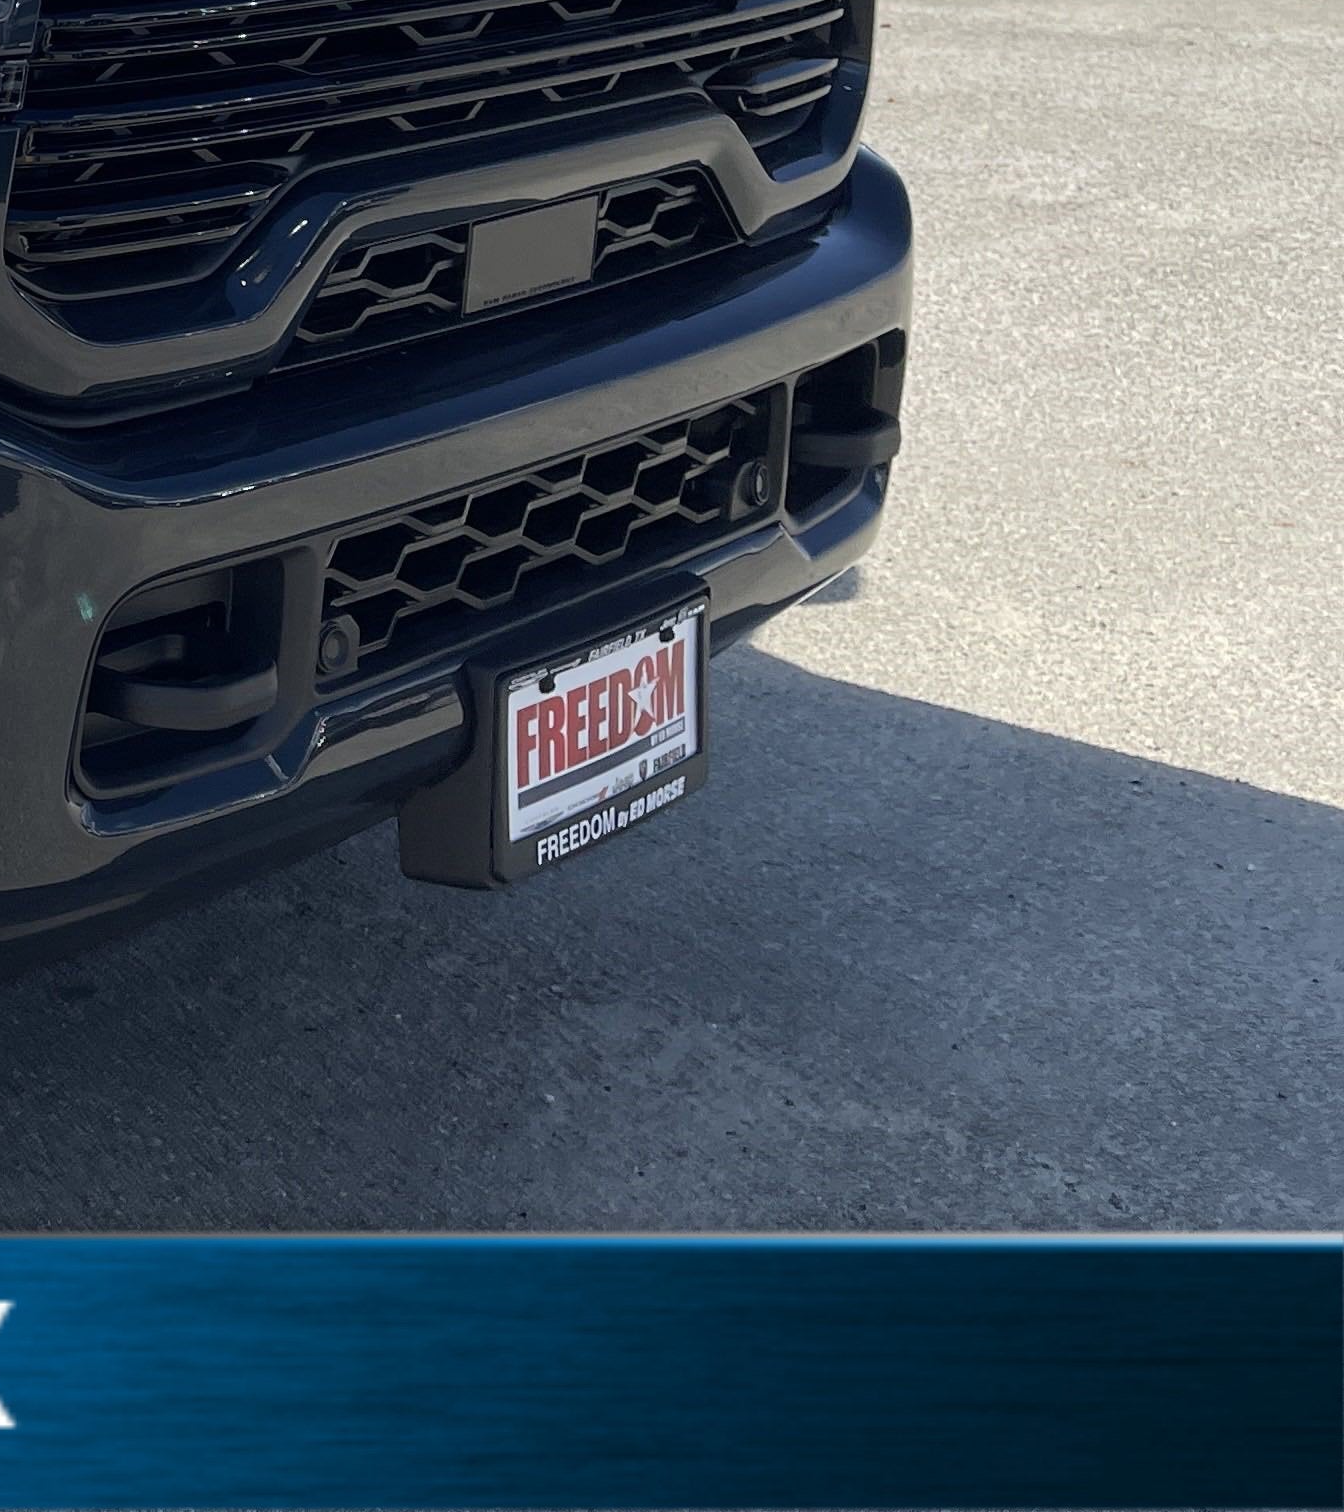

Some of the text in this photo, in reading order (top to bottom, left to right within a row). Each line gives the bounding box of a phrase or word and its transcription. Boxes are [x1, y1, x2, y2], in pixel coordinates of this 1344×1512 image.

[516, 638, 686, 789] FREEDOM
[537, 806, 616, 867] FREEDOM
[629, 798, 645, 823] ED
[646, 776, 686, 813] MORSE
